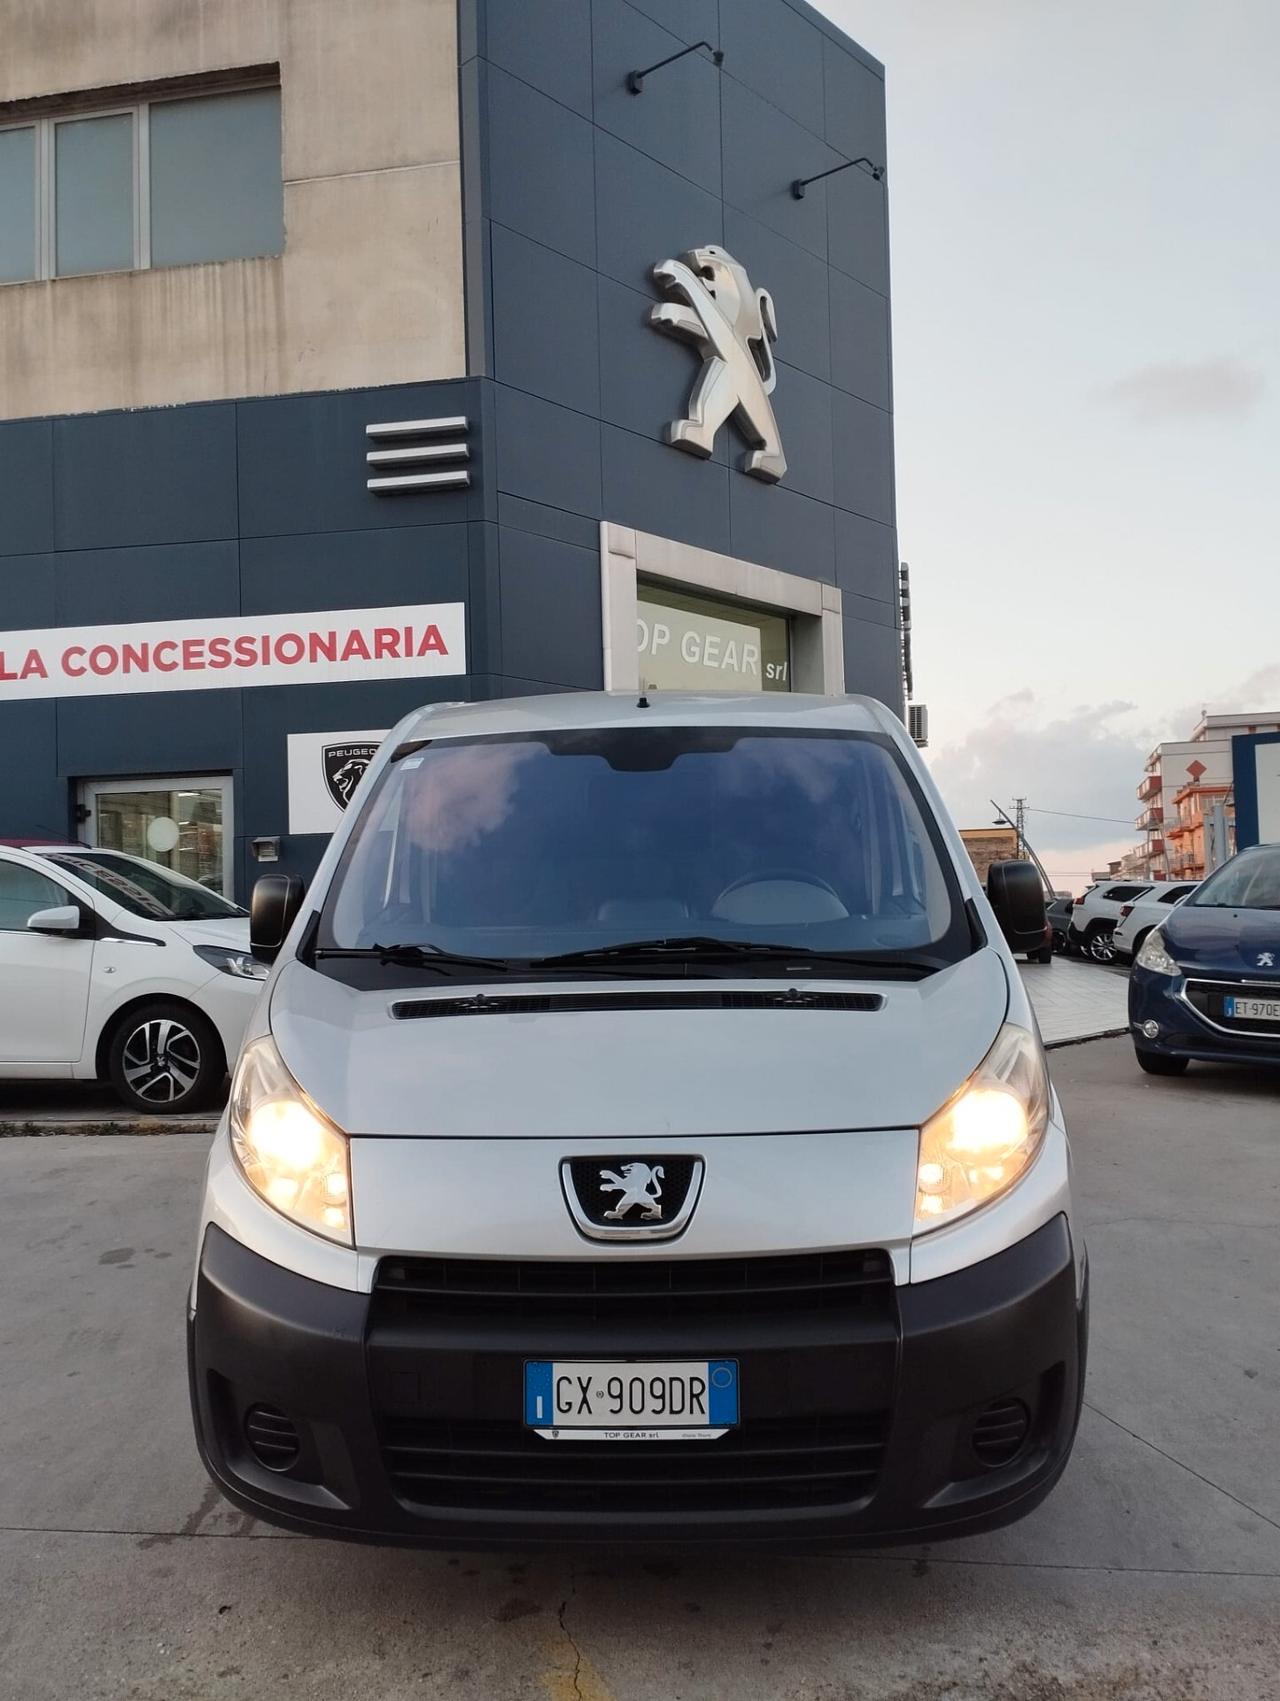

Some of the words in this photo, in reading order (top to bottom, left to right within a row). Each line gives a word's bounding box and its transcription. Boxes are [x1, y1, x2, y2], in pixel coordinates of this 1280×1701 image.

[0, 649, 48, 681] LA
[61, 624, 449, 678] CONCESSIONARIA
[637, 618, 670, 655] OP
[681, 631, 760, 675] GEAR
[766, 661, 788, 681] srl
[328, 748, 377, 758] PEUGEO
[556, 1376, 593, 1414] GX
[607, 1376, 706, 1415] 909DR
